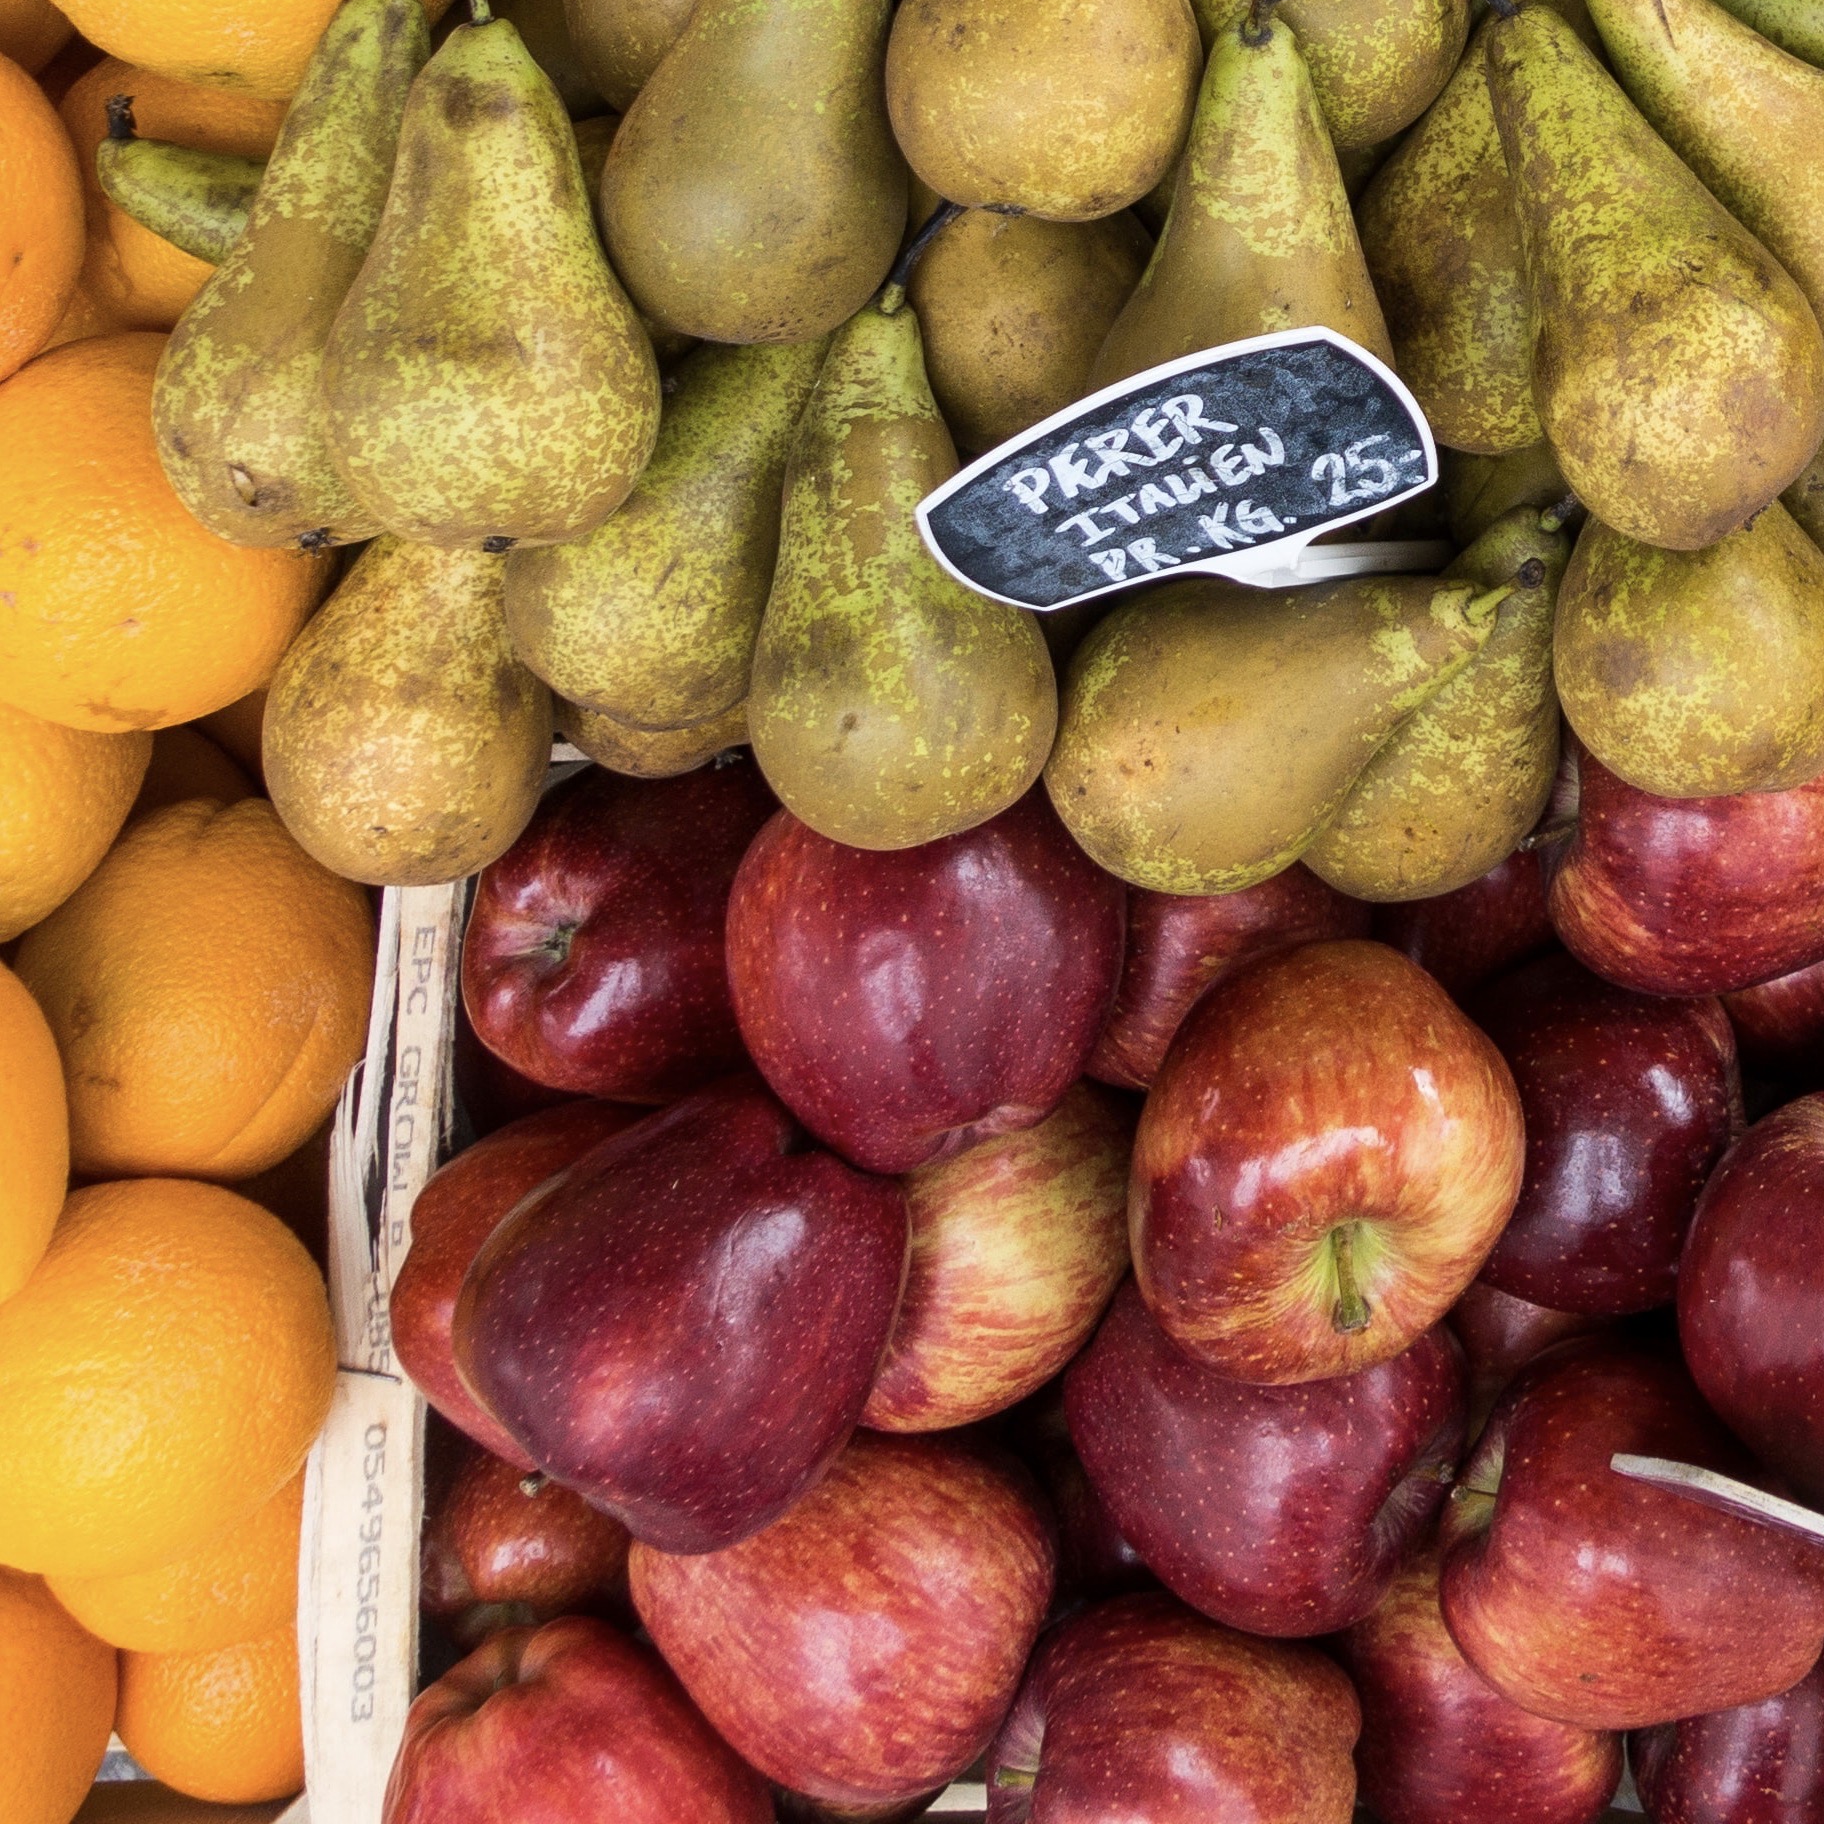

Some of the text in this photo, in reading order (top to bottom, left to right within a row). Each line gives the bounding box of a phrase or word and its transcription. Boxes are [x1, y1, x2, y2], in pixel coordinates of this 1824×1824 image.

[1003, 394, 1238, 515] PÆRER
[1057, 427, 1284, 547] ITALIEN
[1200, 499, 1297, 550] KG.
[404, 925, 436, 1016] EPC
[350, 1422, 387, 1724] 0549656003
